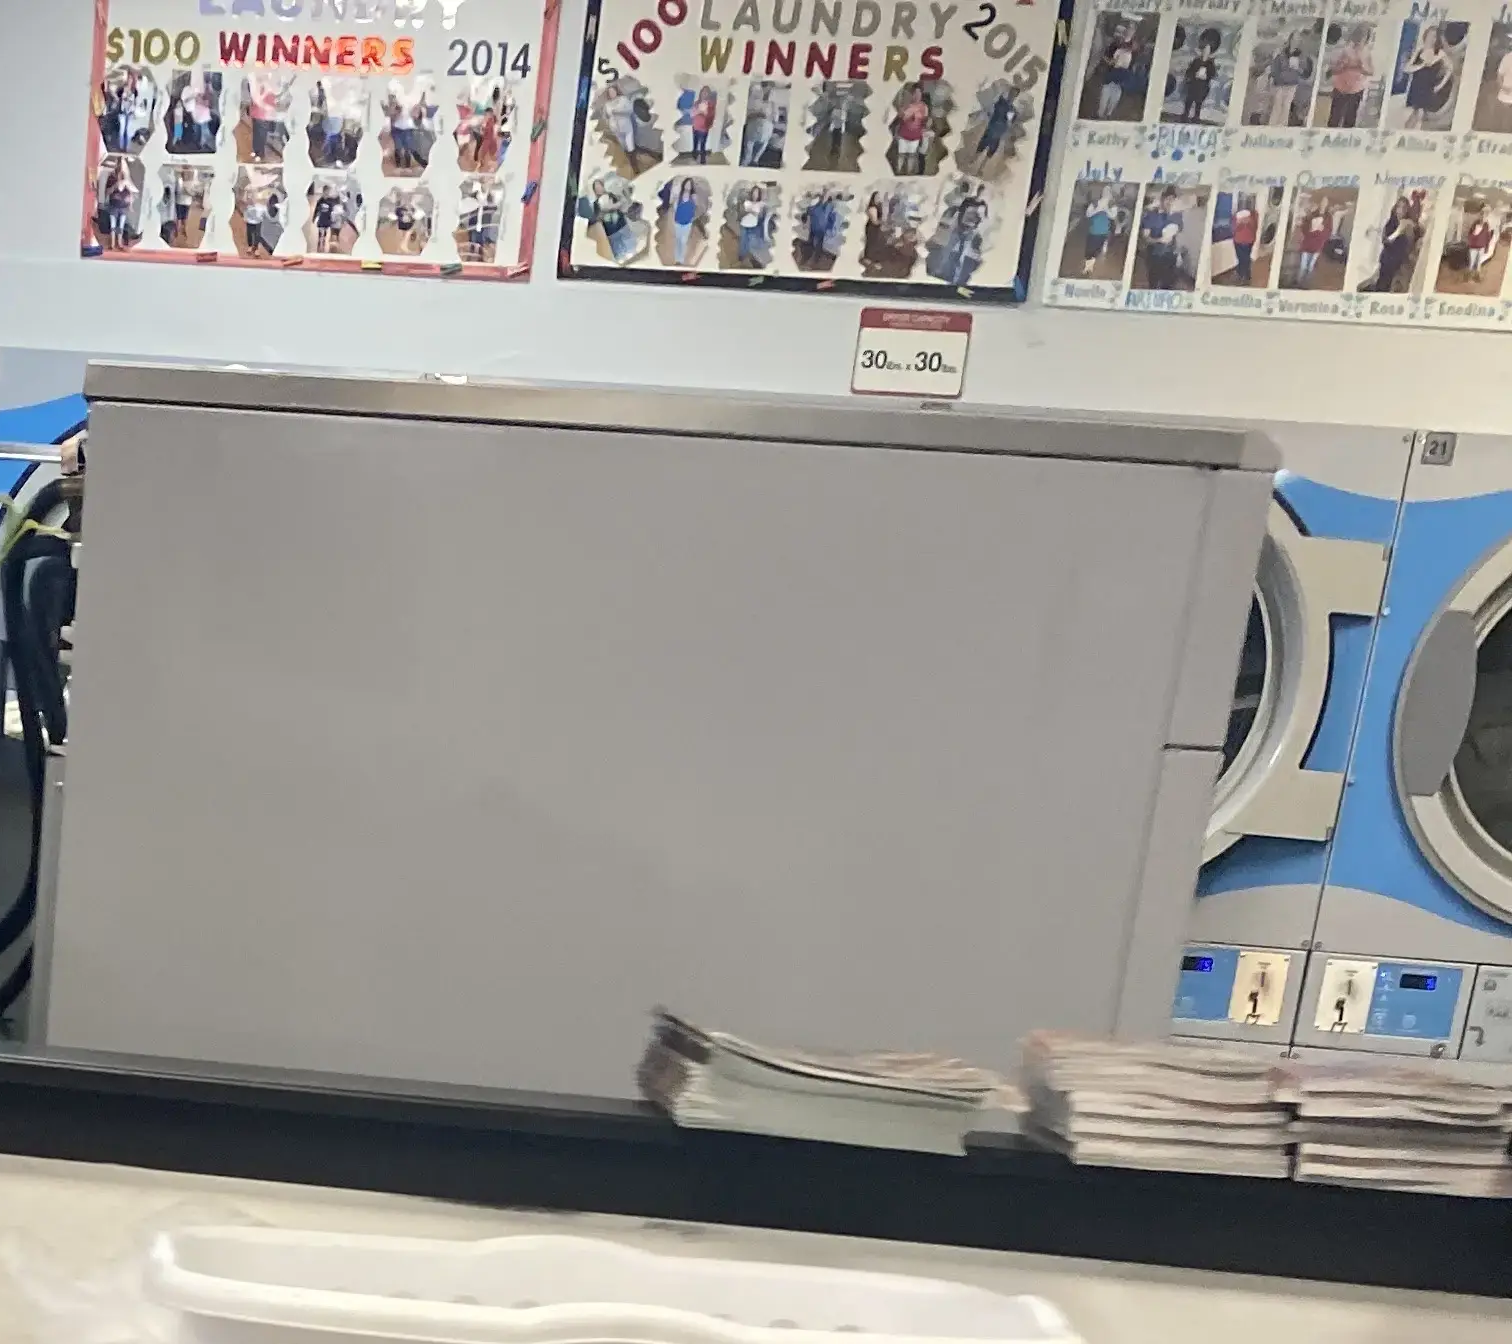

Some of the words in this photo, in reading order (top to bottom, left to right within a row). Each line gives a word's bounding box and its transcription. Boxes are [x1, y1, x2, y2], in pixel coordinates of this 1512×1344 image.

[701, 0, 958, 40] LAUNDRY
[106, 27, 200, 66] $100
[219, 30, 415, 76] WINNERS
[446, 38, 531, 79] 2014
[701, 36, 944, 81] WINNERS
[963, 3, 1047, 92] 2015
[861, 349, 888, 370] 30
[914, 351, 942, 373] 30
[1428, 440, 1447, 456] 21
